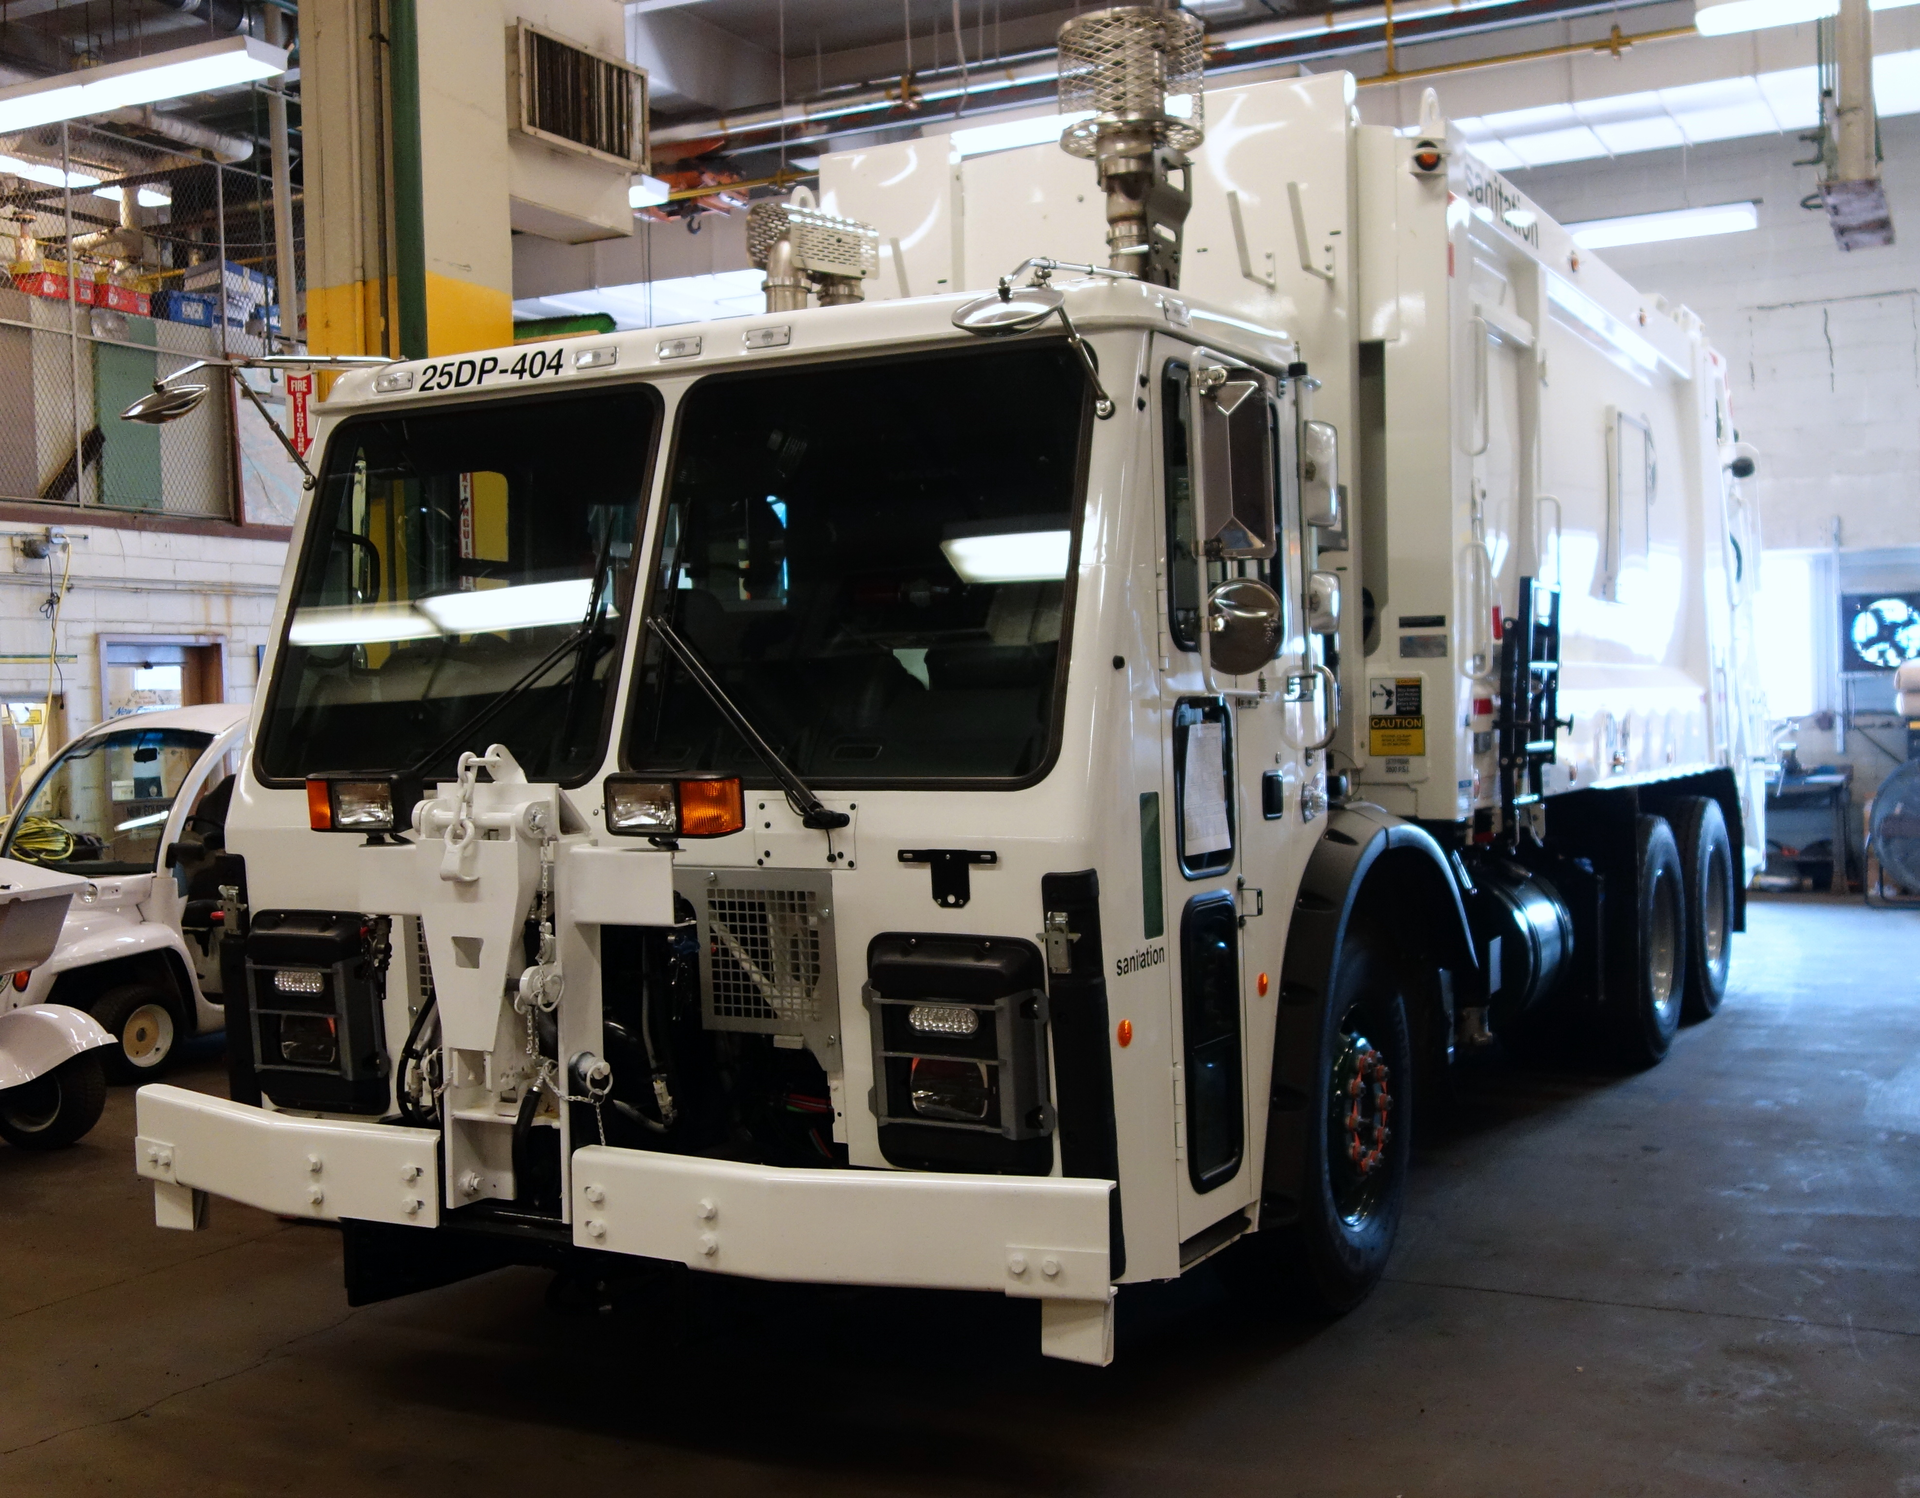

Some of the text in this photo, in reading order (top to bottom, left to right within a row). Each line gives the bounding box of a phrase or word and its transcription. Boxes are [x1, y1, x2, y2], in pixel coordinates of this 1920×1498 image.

[290, 379, 308, 392] FIRE
[419, 348, 564, 392] 25DP-404
[295, 392, 305, 453] EXTINGUISHER
[1371, 718, 1422, 728] CAUTION
[1116, 944, 1165, 977] saniation
